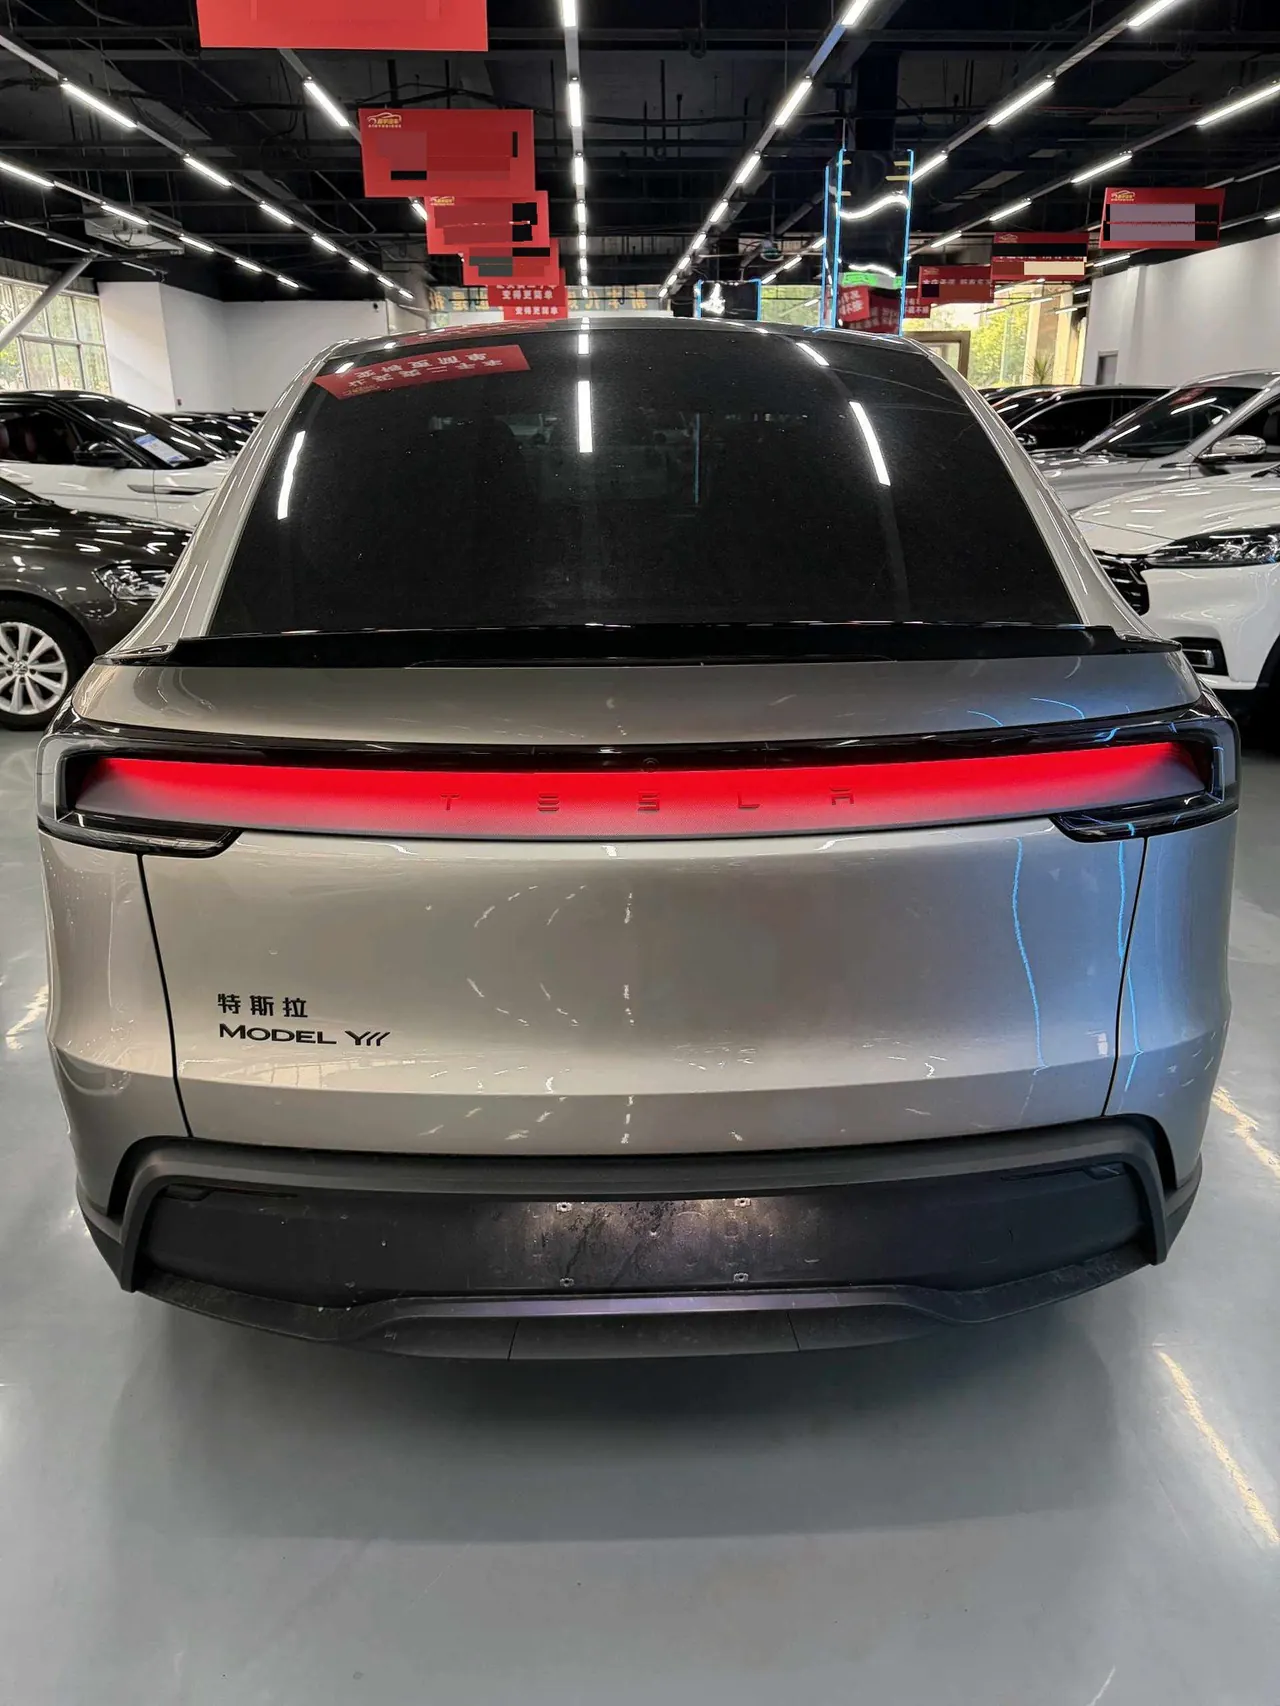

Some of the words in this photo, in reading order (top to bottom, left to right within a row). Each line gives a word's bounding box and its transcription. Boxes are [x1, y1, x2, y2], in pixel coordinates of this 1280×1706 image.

[439, 787, 856, 813] TESLA
[217, 993, 308, 1018] 特斯拉
[219, 1023, 337, 1045] MODEL
